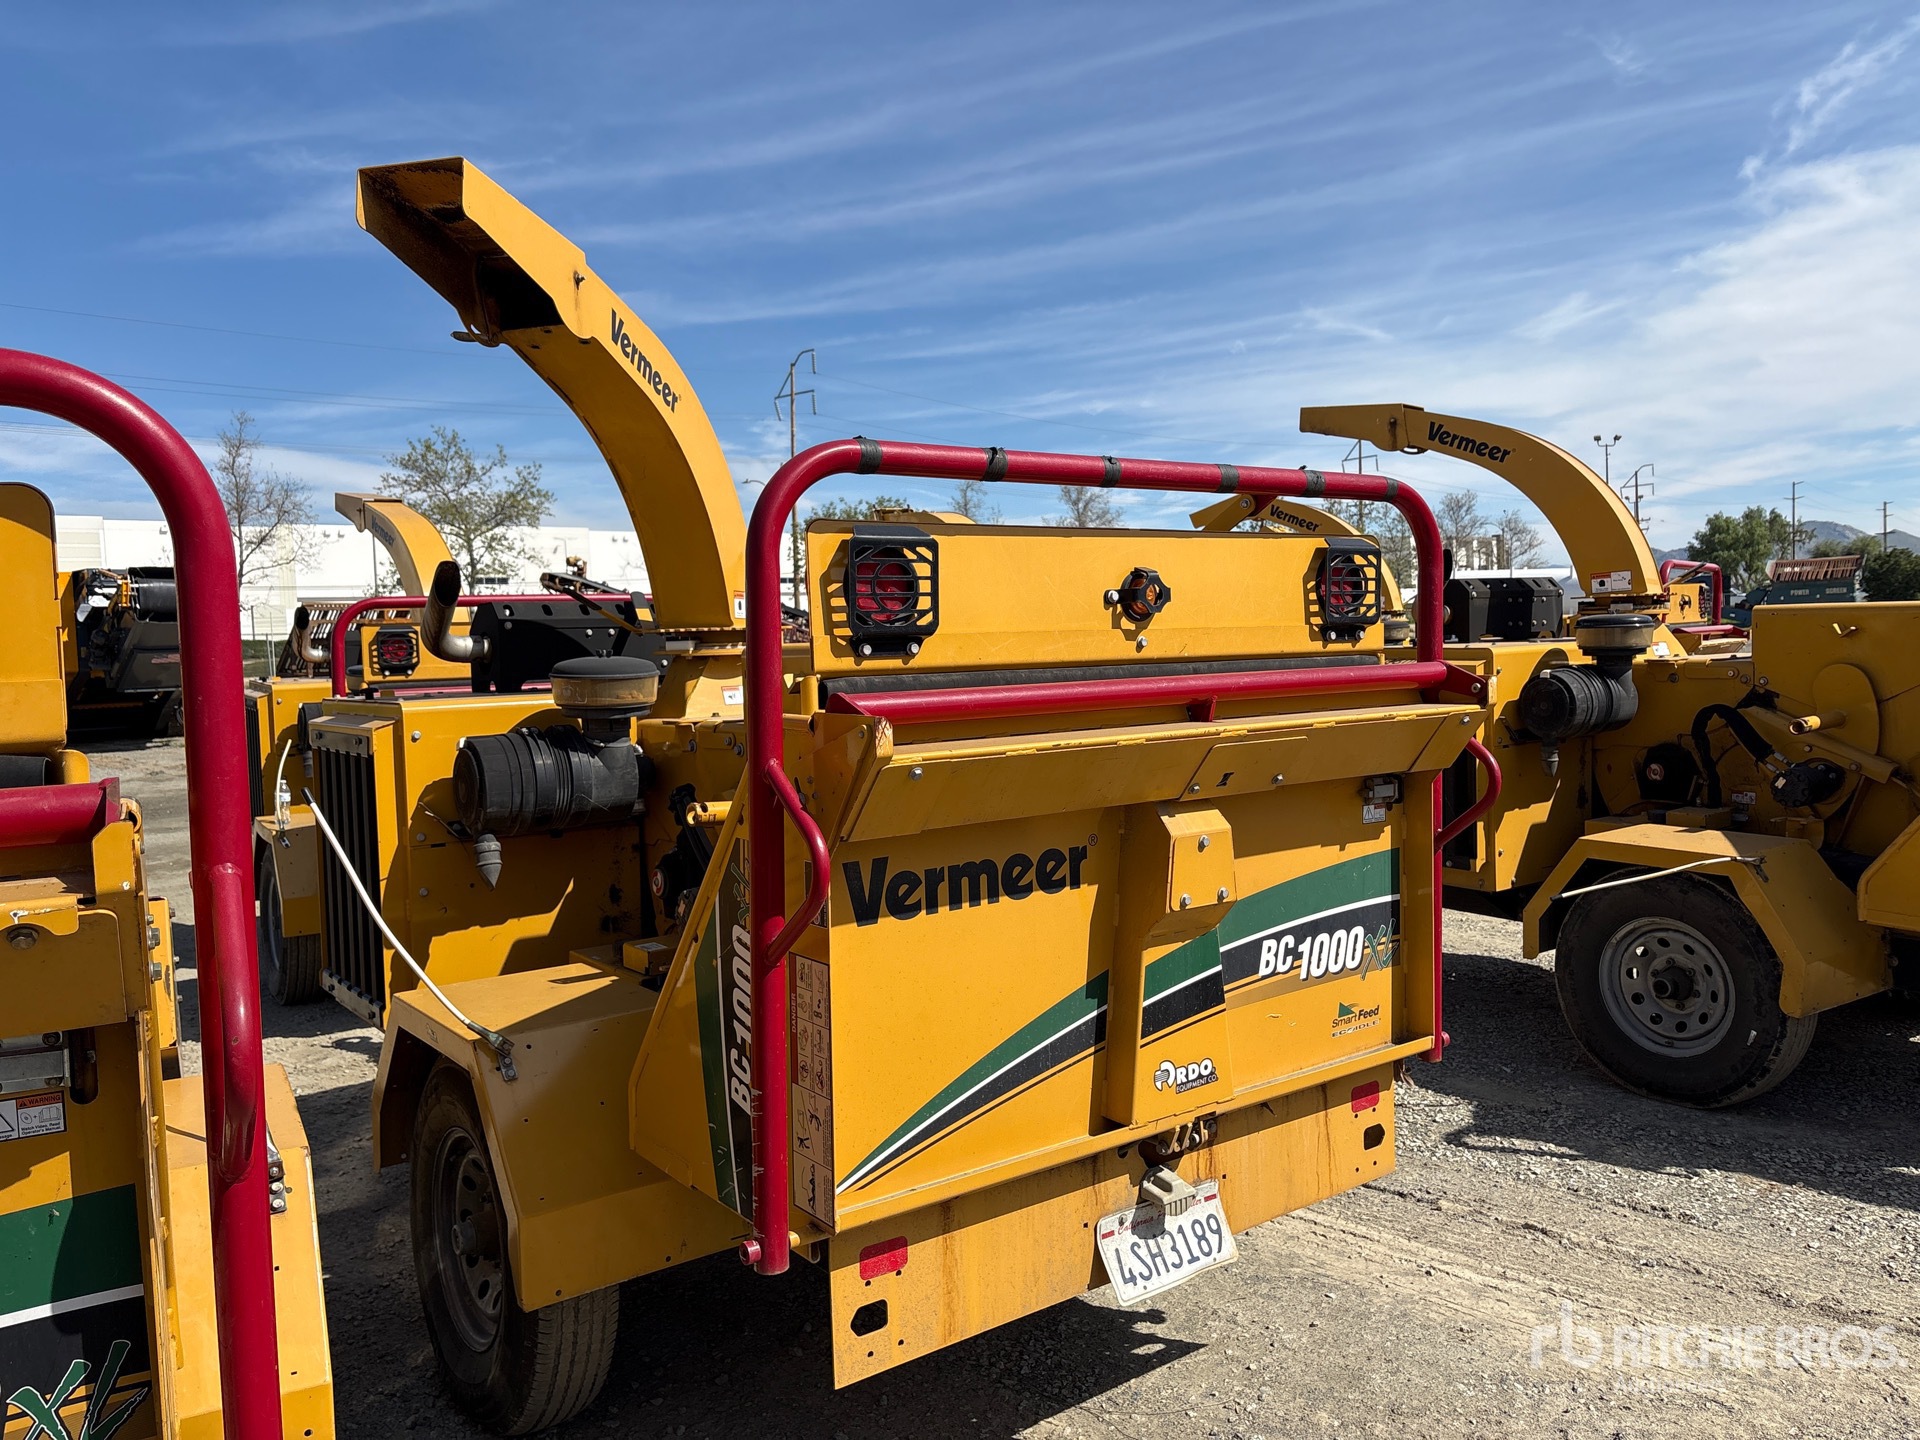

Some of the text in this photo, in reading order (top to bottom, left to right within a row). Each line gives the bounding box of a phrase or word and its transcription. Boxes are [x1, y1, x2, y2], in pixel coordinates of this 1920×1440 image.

[611, 308, 678, 413] Vermeer
[1428, 421, 1511, 463] Vermeer
[1270, 504, 1319, 532] Vermeer
[842, 845, 1088, 927] Vermeer
[28, 1094, 61, 1105] WARNING
[1176, 1076, 1208, 1093] EQUIPMENT
[1117, 1215, 1154, 1235] California
[1115, 1213, 1223, 1286] 4SH3189
